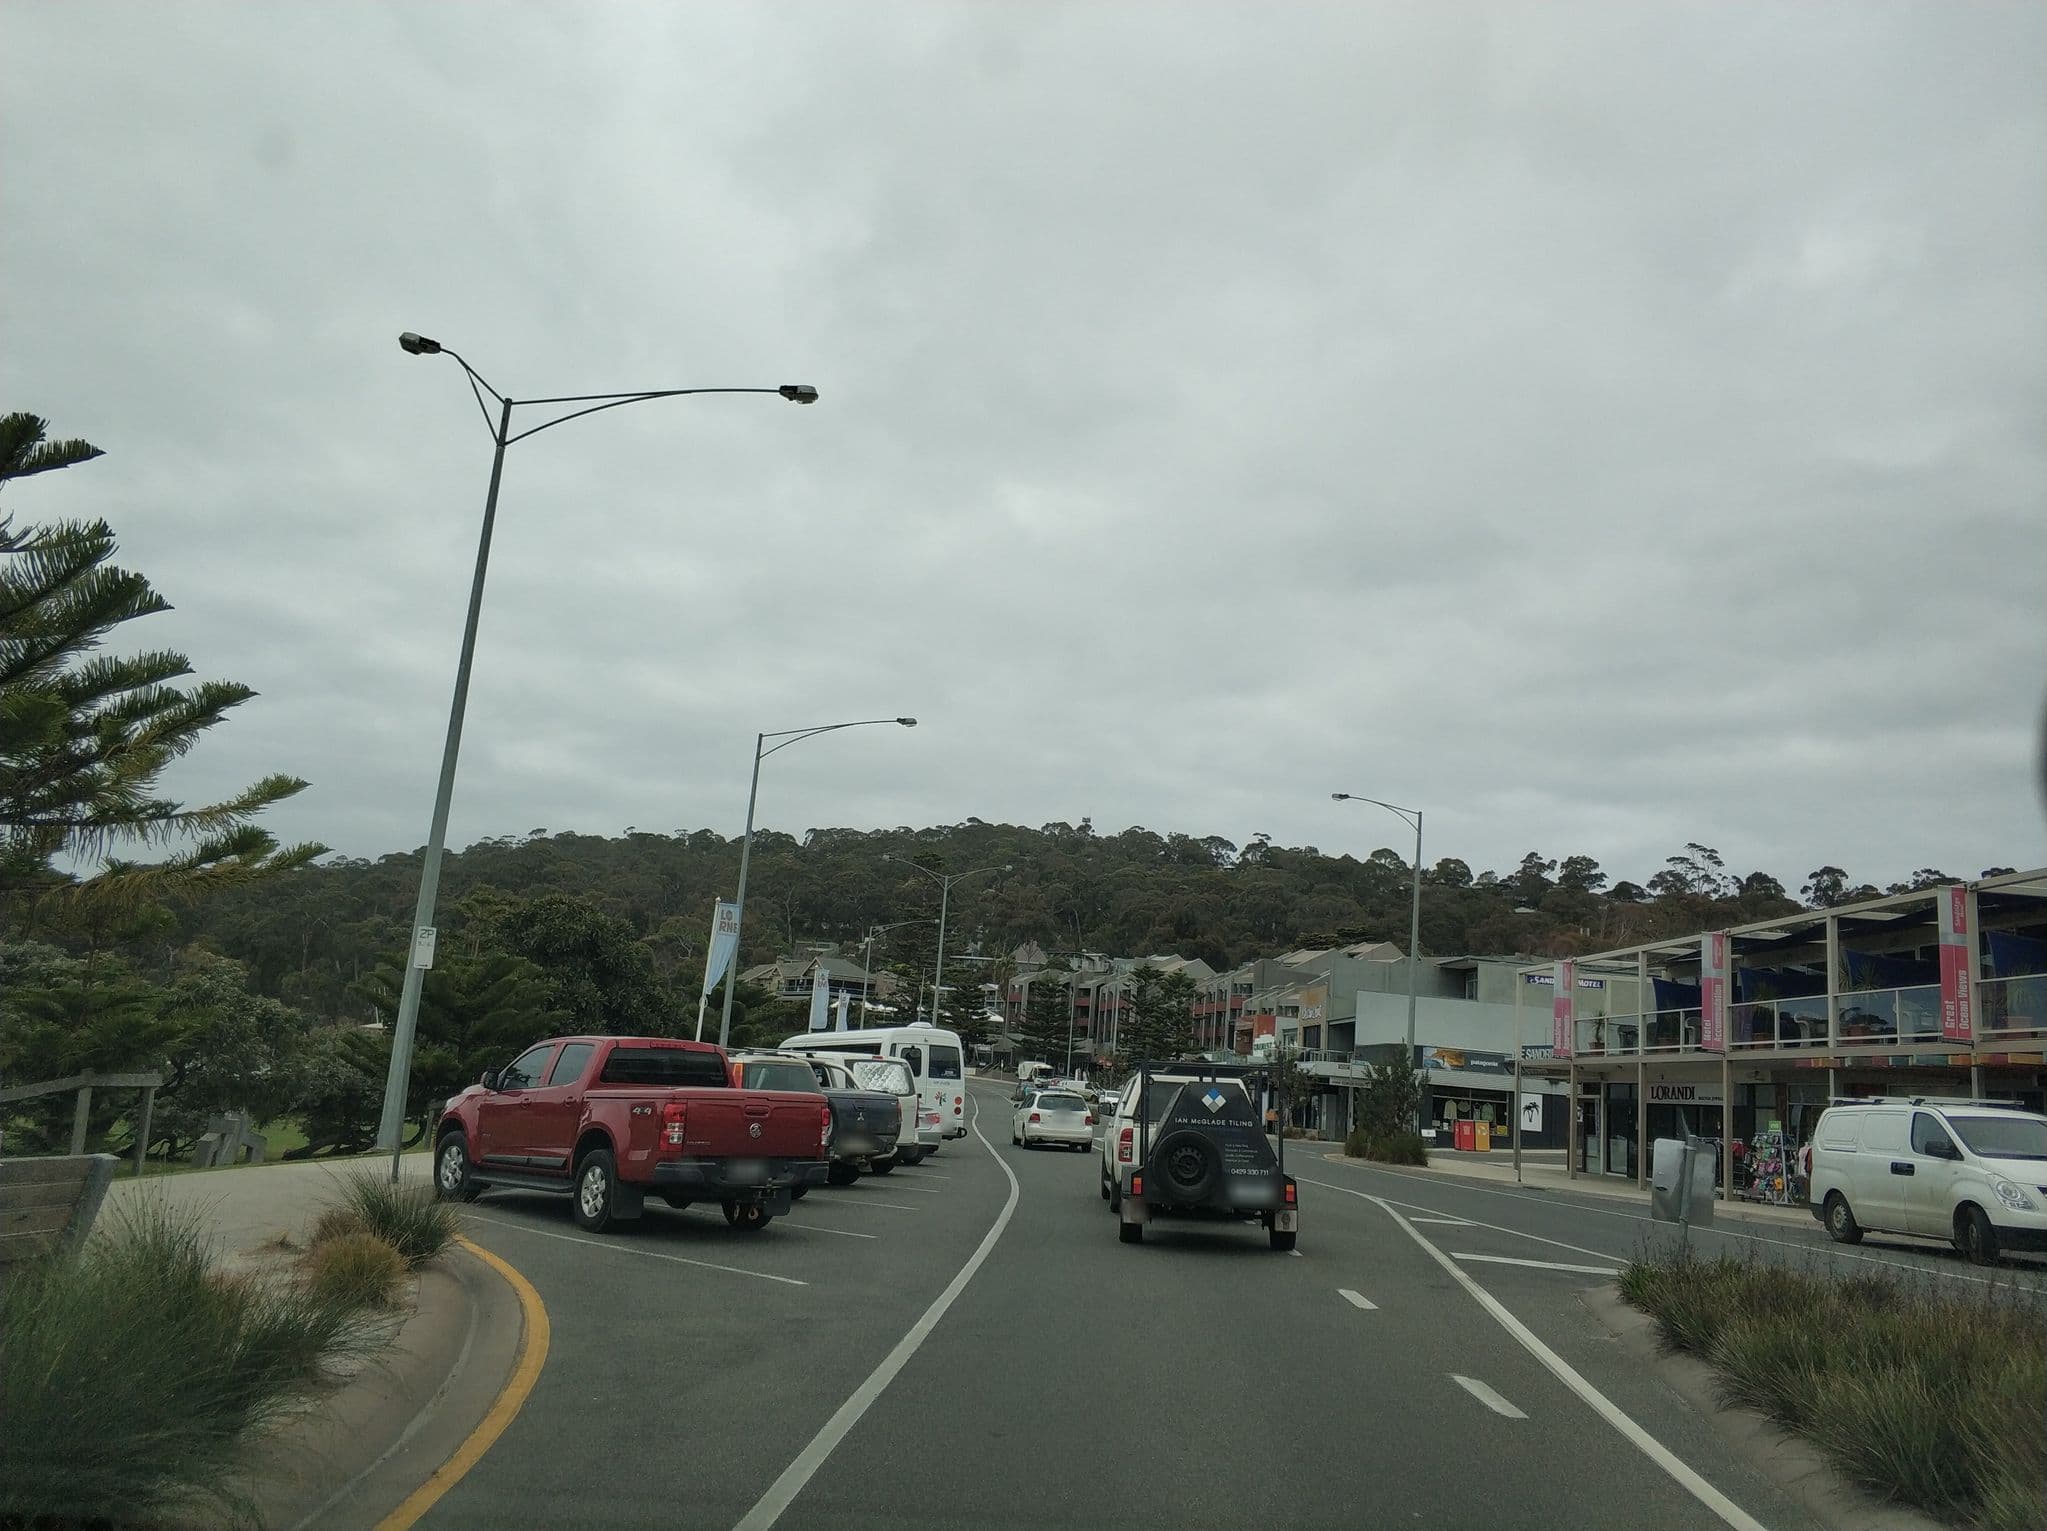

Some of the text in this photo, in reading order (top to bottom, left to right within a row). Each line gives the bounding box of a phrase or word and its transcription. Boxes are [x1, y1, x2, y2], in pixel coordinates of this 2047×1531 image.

[419, 929, 435, 938] 2P
[1534, 976, 1555, 985] SAND
[1957, 970, 1970, 1030] Ocean Views
[1944, 1000, 1955, 1028] Great
[1703, 1019, 1712, 1041] Motel
[1525, 1048, 1552, 1060] SANDR
[1470, 1059, 1498, 1067] patagonia
[1650, 1085, 1695, 1100] LORANDI
